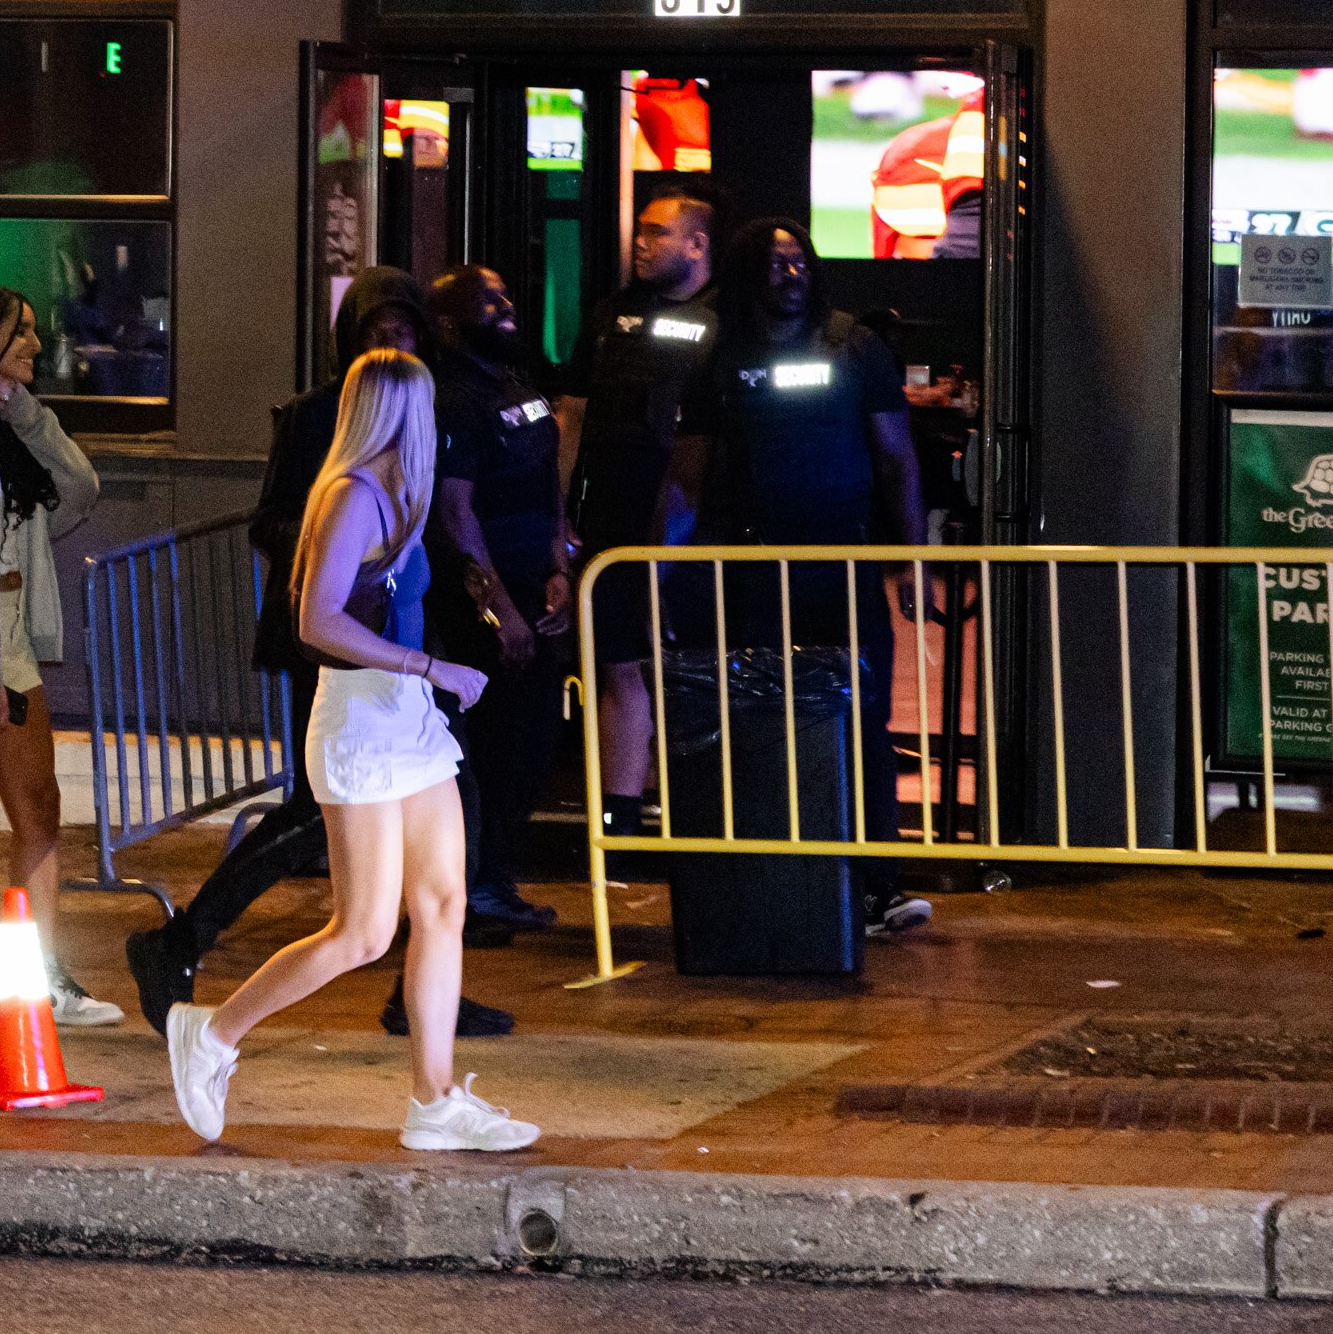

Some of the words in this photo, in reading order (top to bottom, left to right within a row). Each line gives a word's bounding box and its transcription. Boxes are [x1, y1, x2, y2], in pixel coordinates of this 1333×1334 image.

[653, 318, 706, 342] SECURITY
[773, 364, 831, 387] SECURITY
[1261, 507, 1288, 522] the
[1263, 566, 1328, 591] CUS
[1270, 651, 1324, 664] PARKING
[1295, 680, 1330, 691] FIRST
[1272, 706, 1309, 718] VALID
[1311, 708, 1328, 718] AT
[1269, 719, 1323, 732] PARKING
